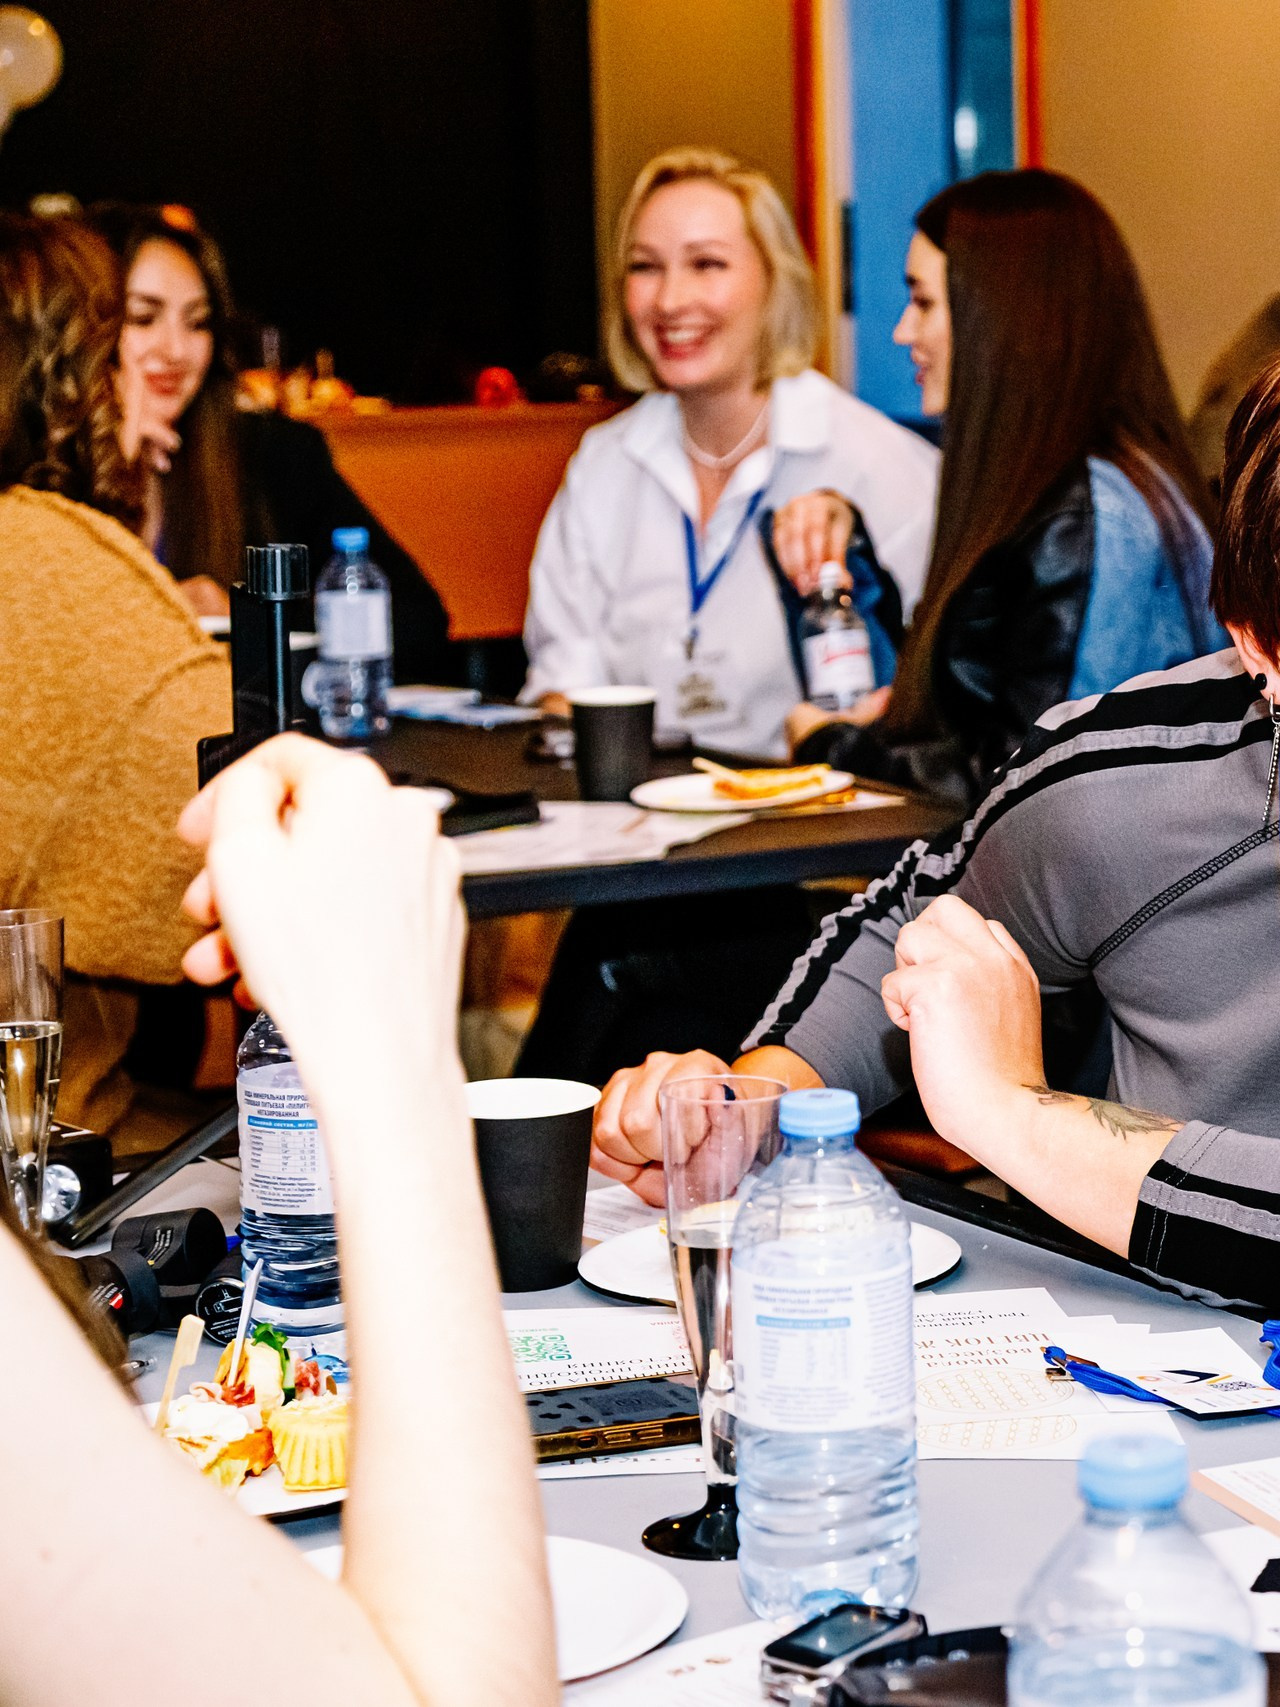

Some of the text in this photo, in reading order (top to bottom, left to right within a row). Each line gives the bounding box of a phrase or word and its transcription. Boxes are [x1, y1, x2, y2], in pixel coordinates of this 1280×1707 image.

[914, 1333, 1053, 1350] ЦВЕТОК Ж
[518, 1366, 632, 1380] ПРОВОДН
